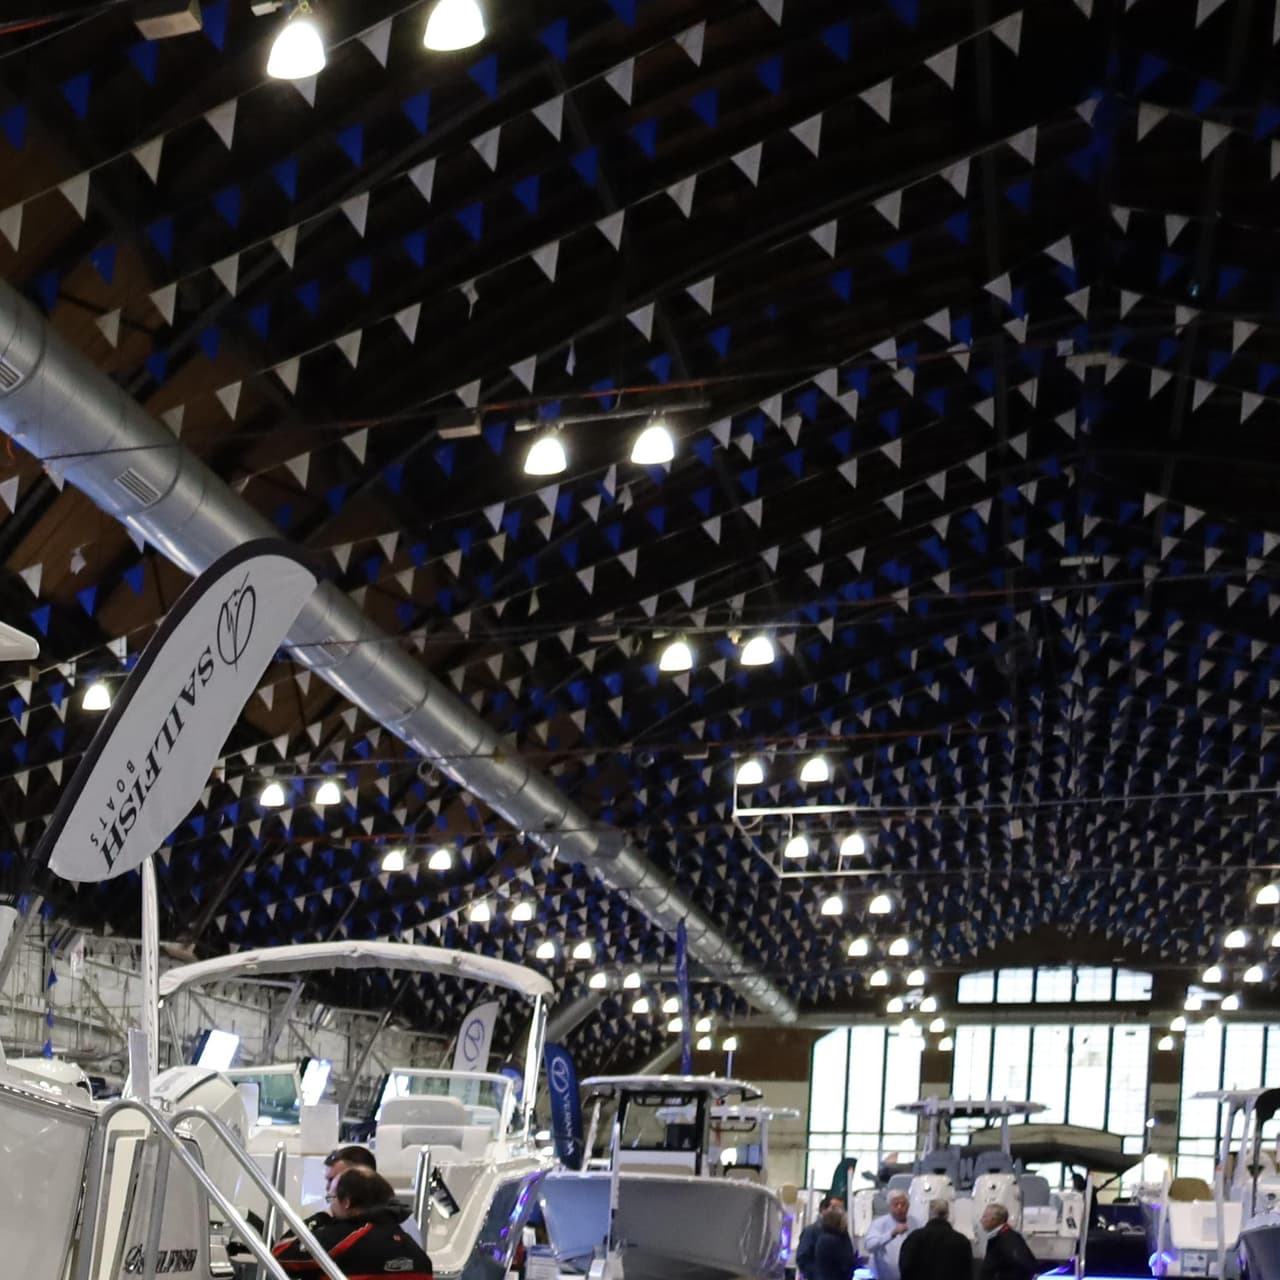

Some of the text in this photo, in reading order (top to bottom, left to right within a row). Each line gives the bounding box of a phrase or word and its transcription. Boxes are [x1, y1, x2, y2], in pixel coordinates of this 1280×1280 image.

[89, 758, 136, 848] BOATS
[99, 645, 214, 874] SAILFISH
[135, 1248, 198, 1275] SILFISH
